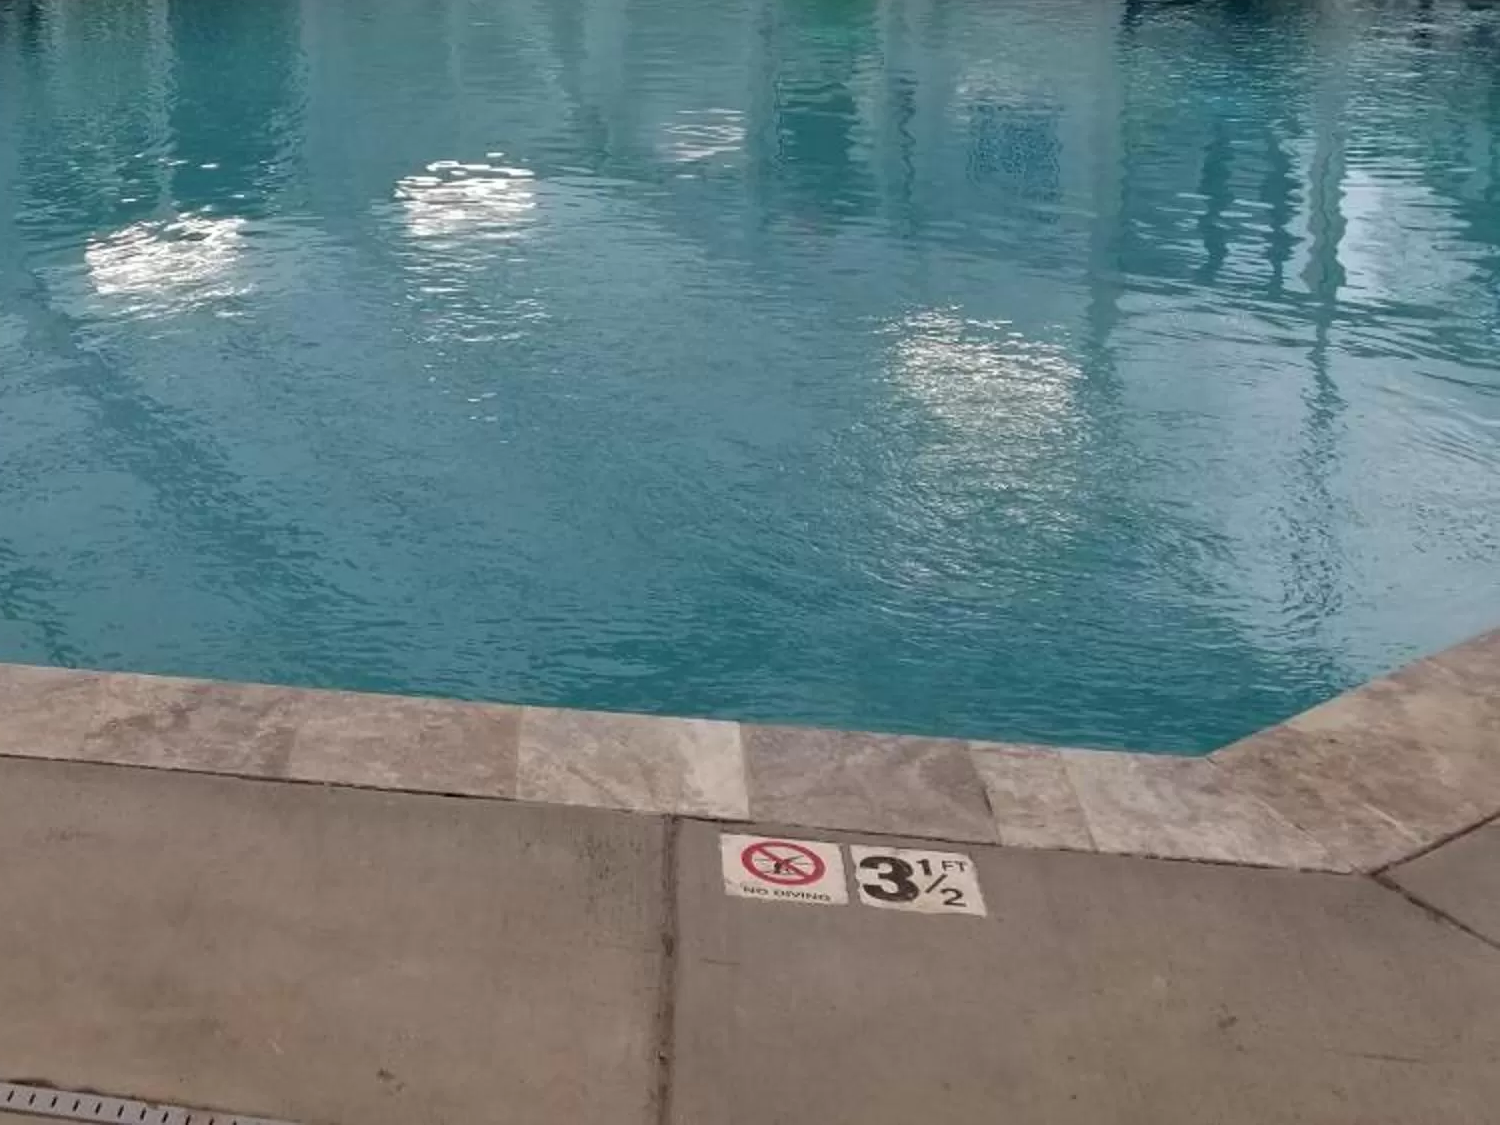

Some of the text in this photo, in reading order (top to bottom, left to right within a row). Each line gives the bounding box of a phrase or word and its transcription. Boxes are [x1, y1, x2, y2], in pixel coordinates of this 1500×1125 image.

[742, 885, 832, 902] NO DIVING
[860, 856, 920, 902] 3
[941, 860, 967, 872] FT
